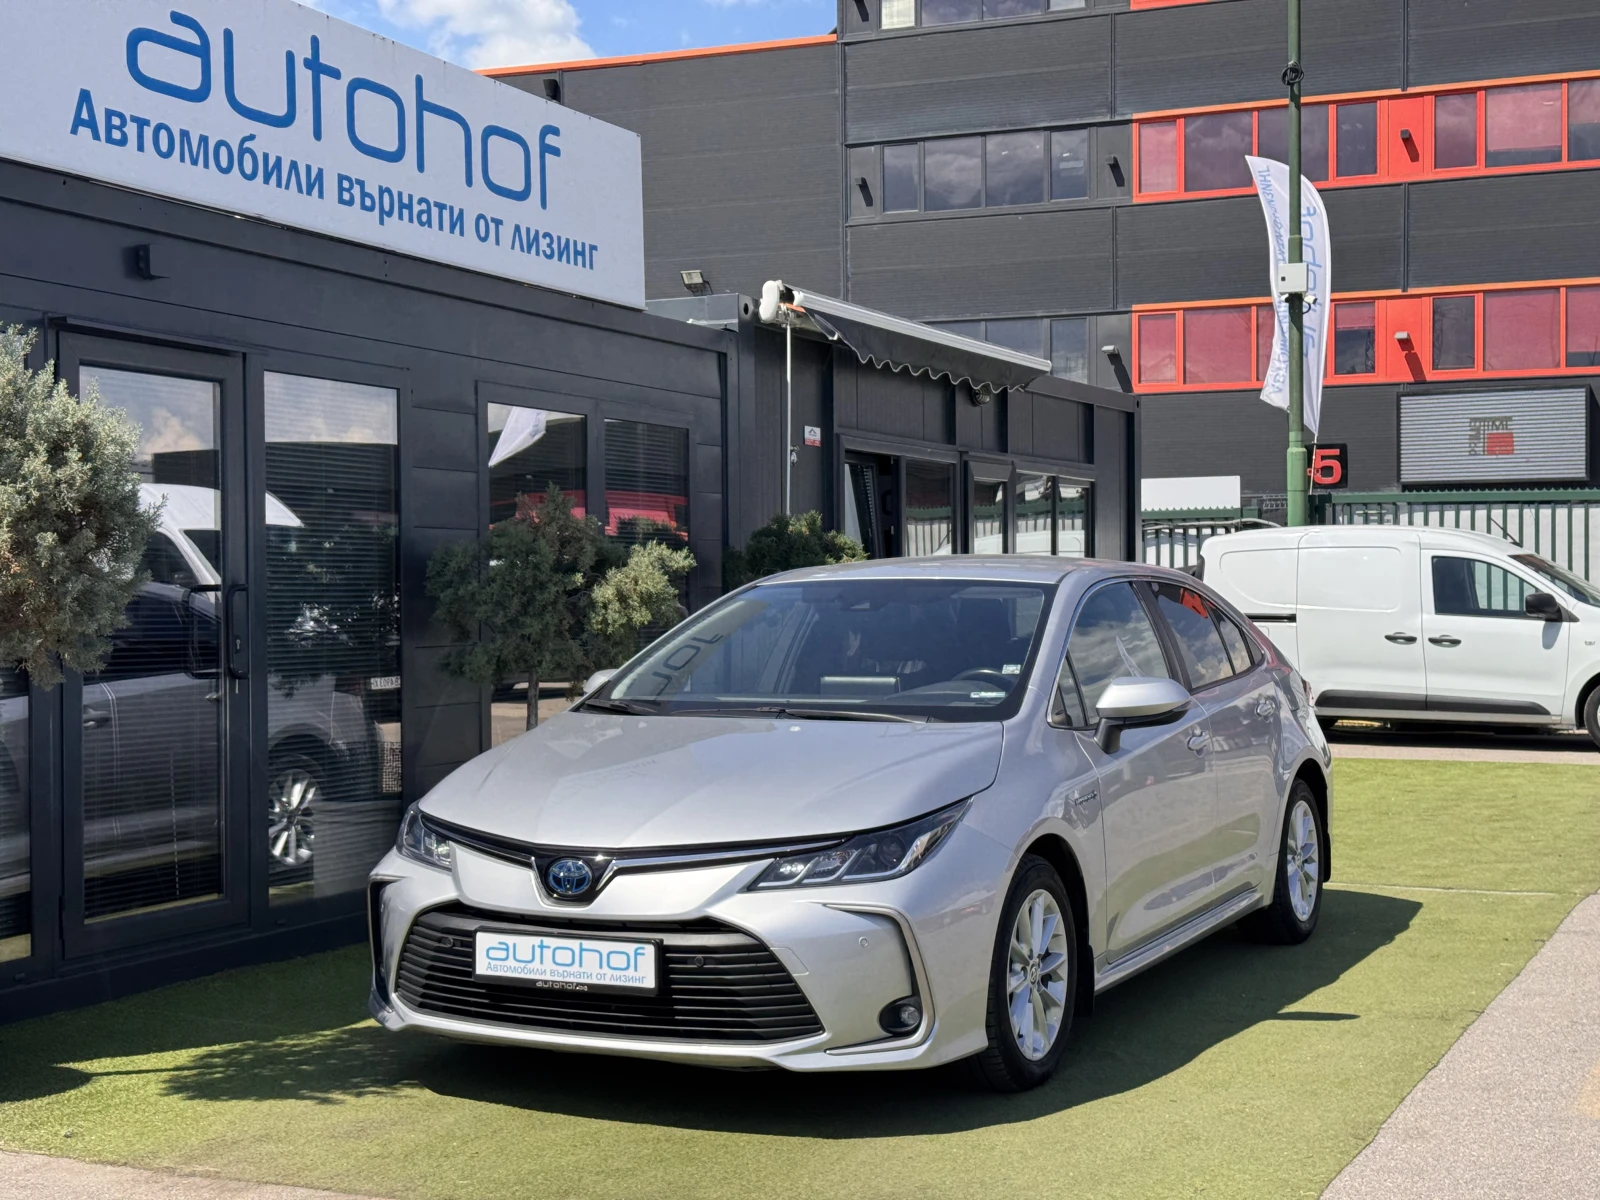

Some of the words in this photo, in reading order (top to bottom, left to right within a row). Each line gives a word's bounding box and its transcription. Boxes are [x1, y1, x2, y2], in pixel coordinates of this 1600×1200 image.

[126, 10, 561, 210] autohof
[69, 88, 325, 200] Автомобили
[336, 173, 465, 237] върнати
[474, 213, 504, 246] от
[511, 223, 598, 271] лизинг
[1314, 448, 1342, 485] 5
[485, 939, 646, 972] autohof
[486, 961, 547, 977] Автомобили
[550, 968, 593, 980] върнати
[595, 972, 607, 982] от
[609, 973, 647, 984] лизинг
